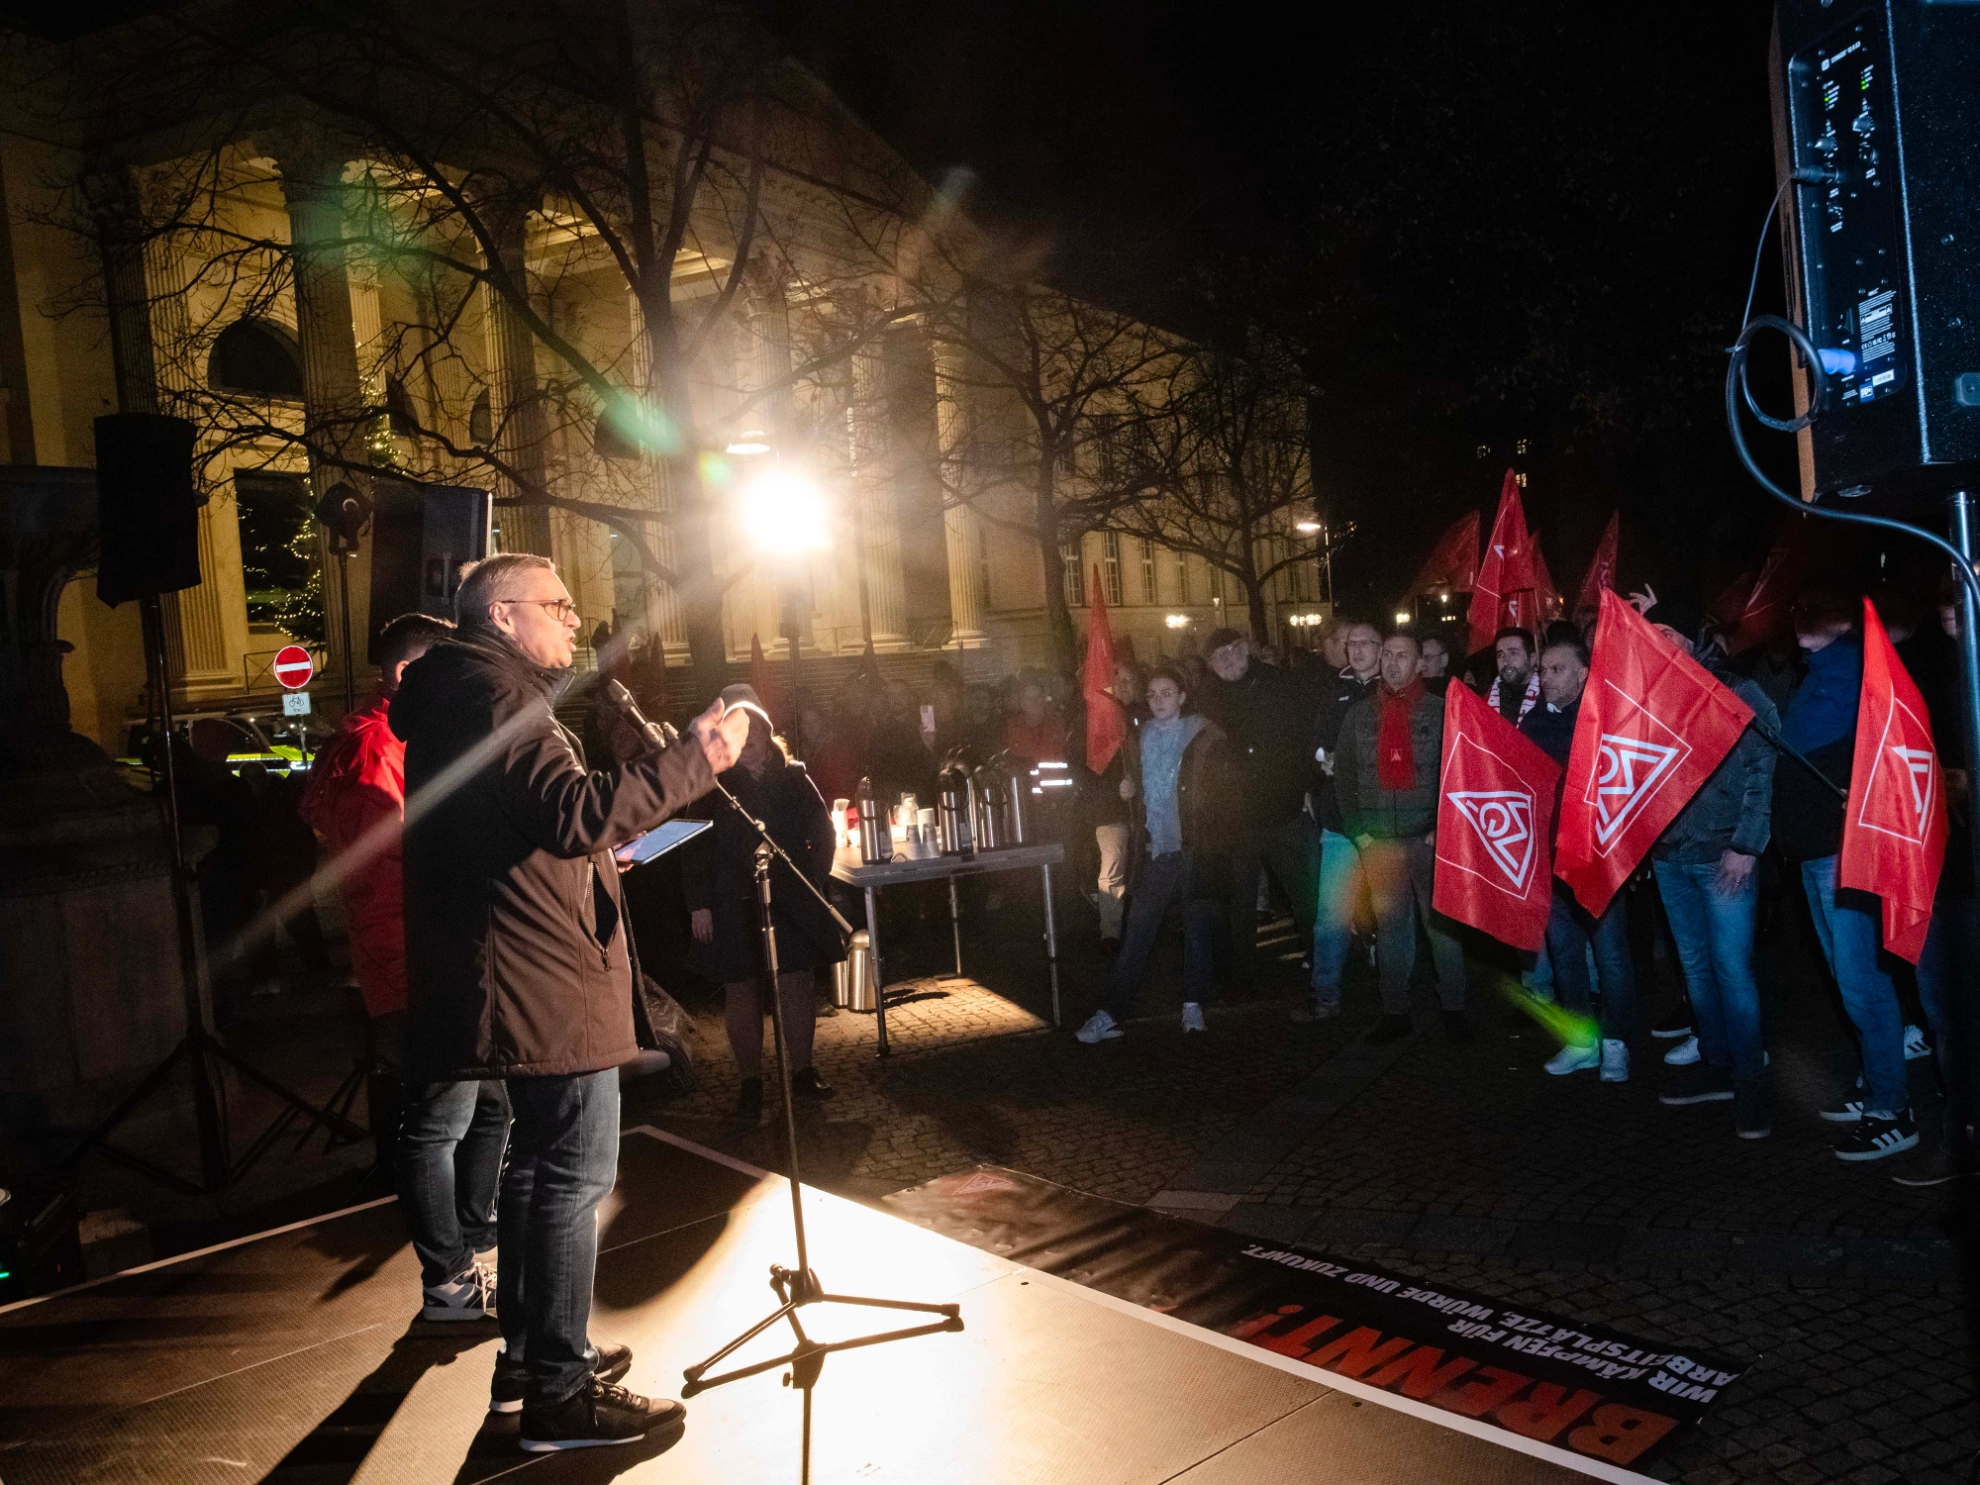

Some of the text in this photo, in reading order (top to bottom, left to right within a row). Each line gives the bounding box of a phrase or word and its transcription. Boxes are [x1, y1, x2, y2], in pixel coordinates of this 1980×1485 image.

[1232, 1304, 1681, 1466] BRENNT!
[1240, 1243, 1741, 1387] ARBEITSPLÄTZE, WÜRDE UND ZUKUNFT.
[1447, 1319, 1719, 1404] WIR KÄMPFEN FÜR
